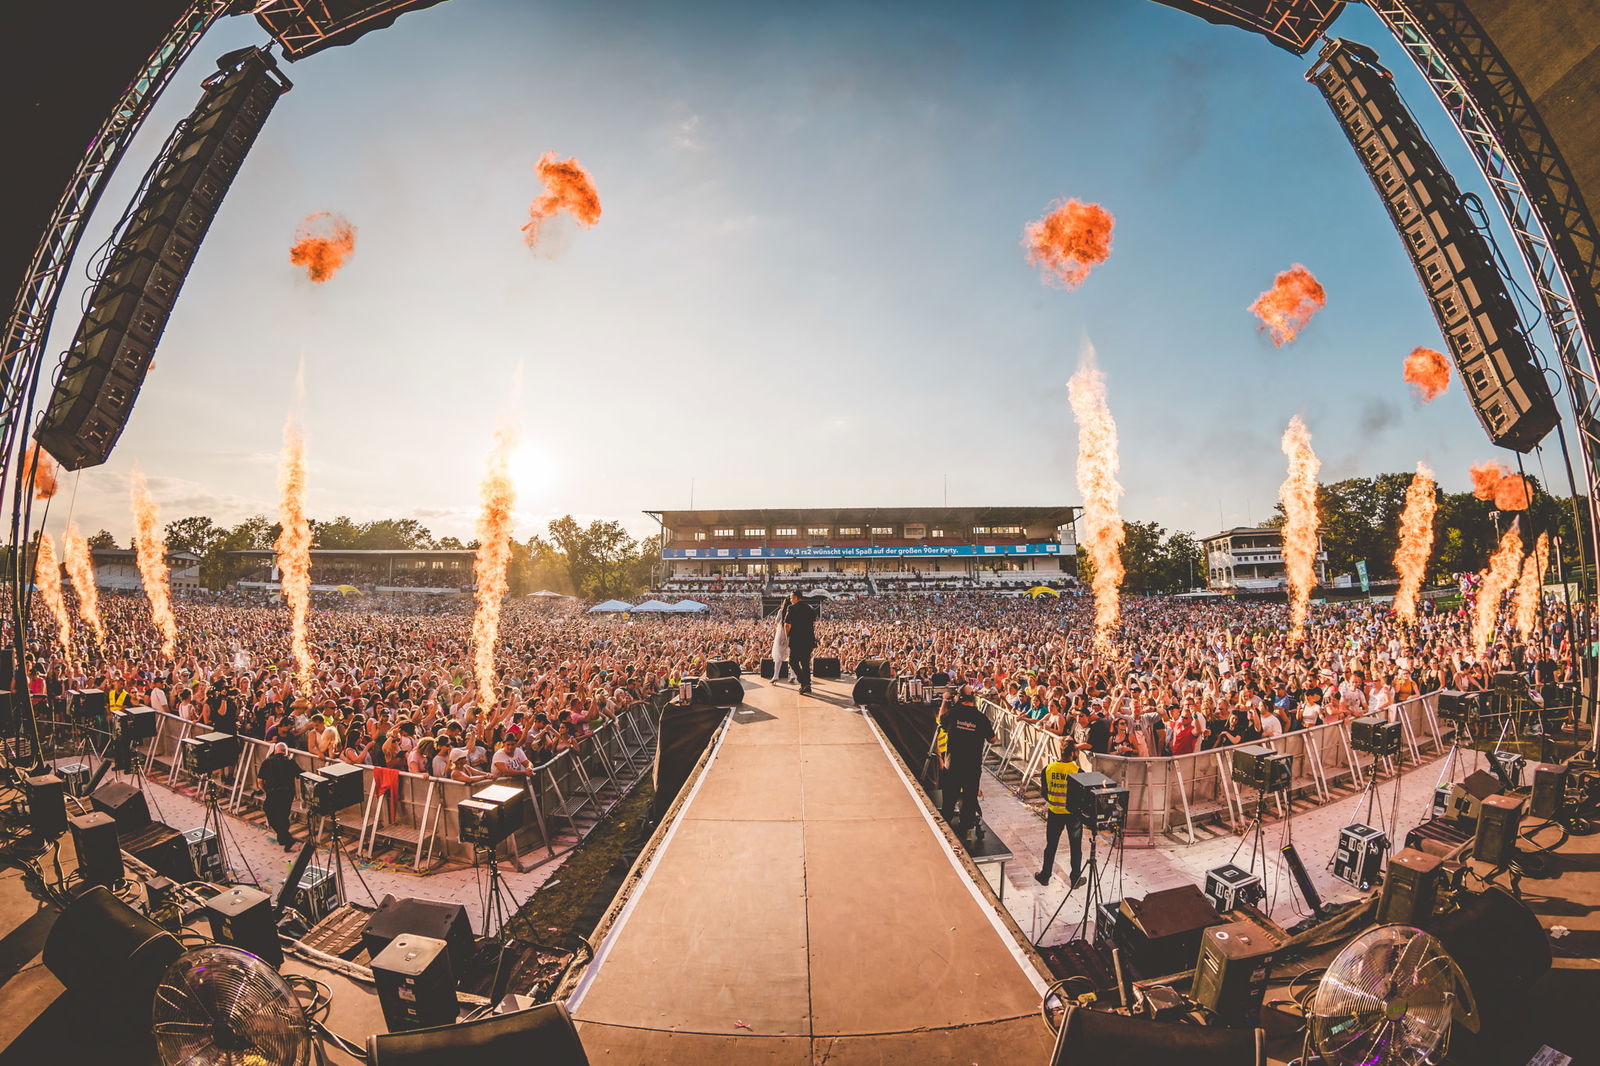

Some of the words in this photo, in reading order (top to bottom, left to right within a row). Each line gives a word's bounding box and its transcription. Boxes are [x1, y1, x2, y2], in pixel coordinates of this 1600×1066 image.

[855, 548, 872, 556] Spaß
[898, 547, 922, 556] großen
[940, 547, 959, 555] Party.
